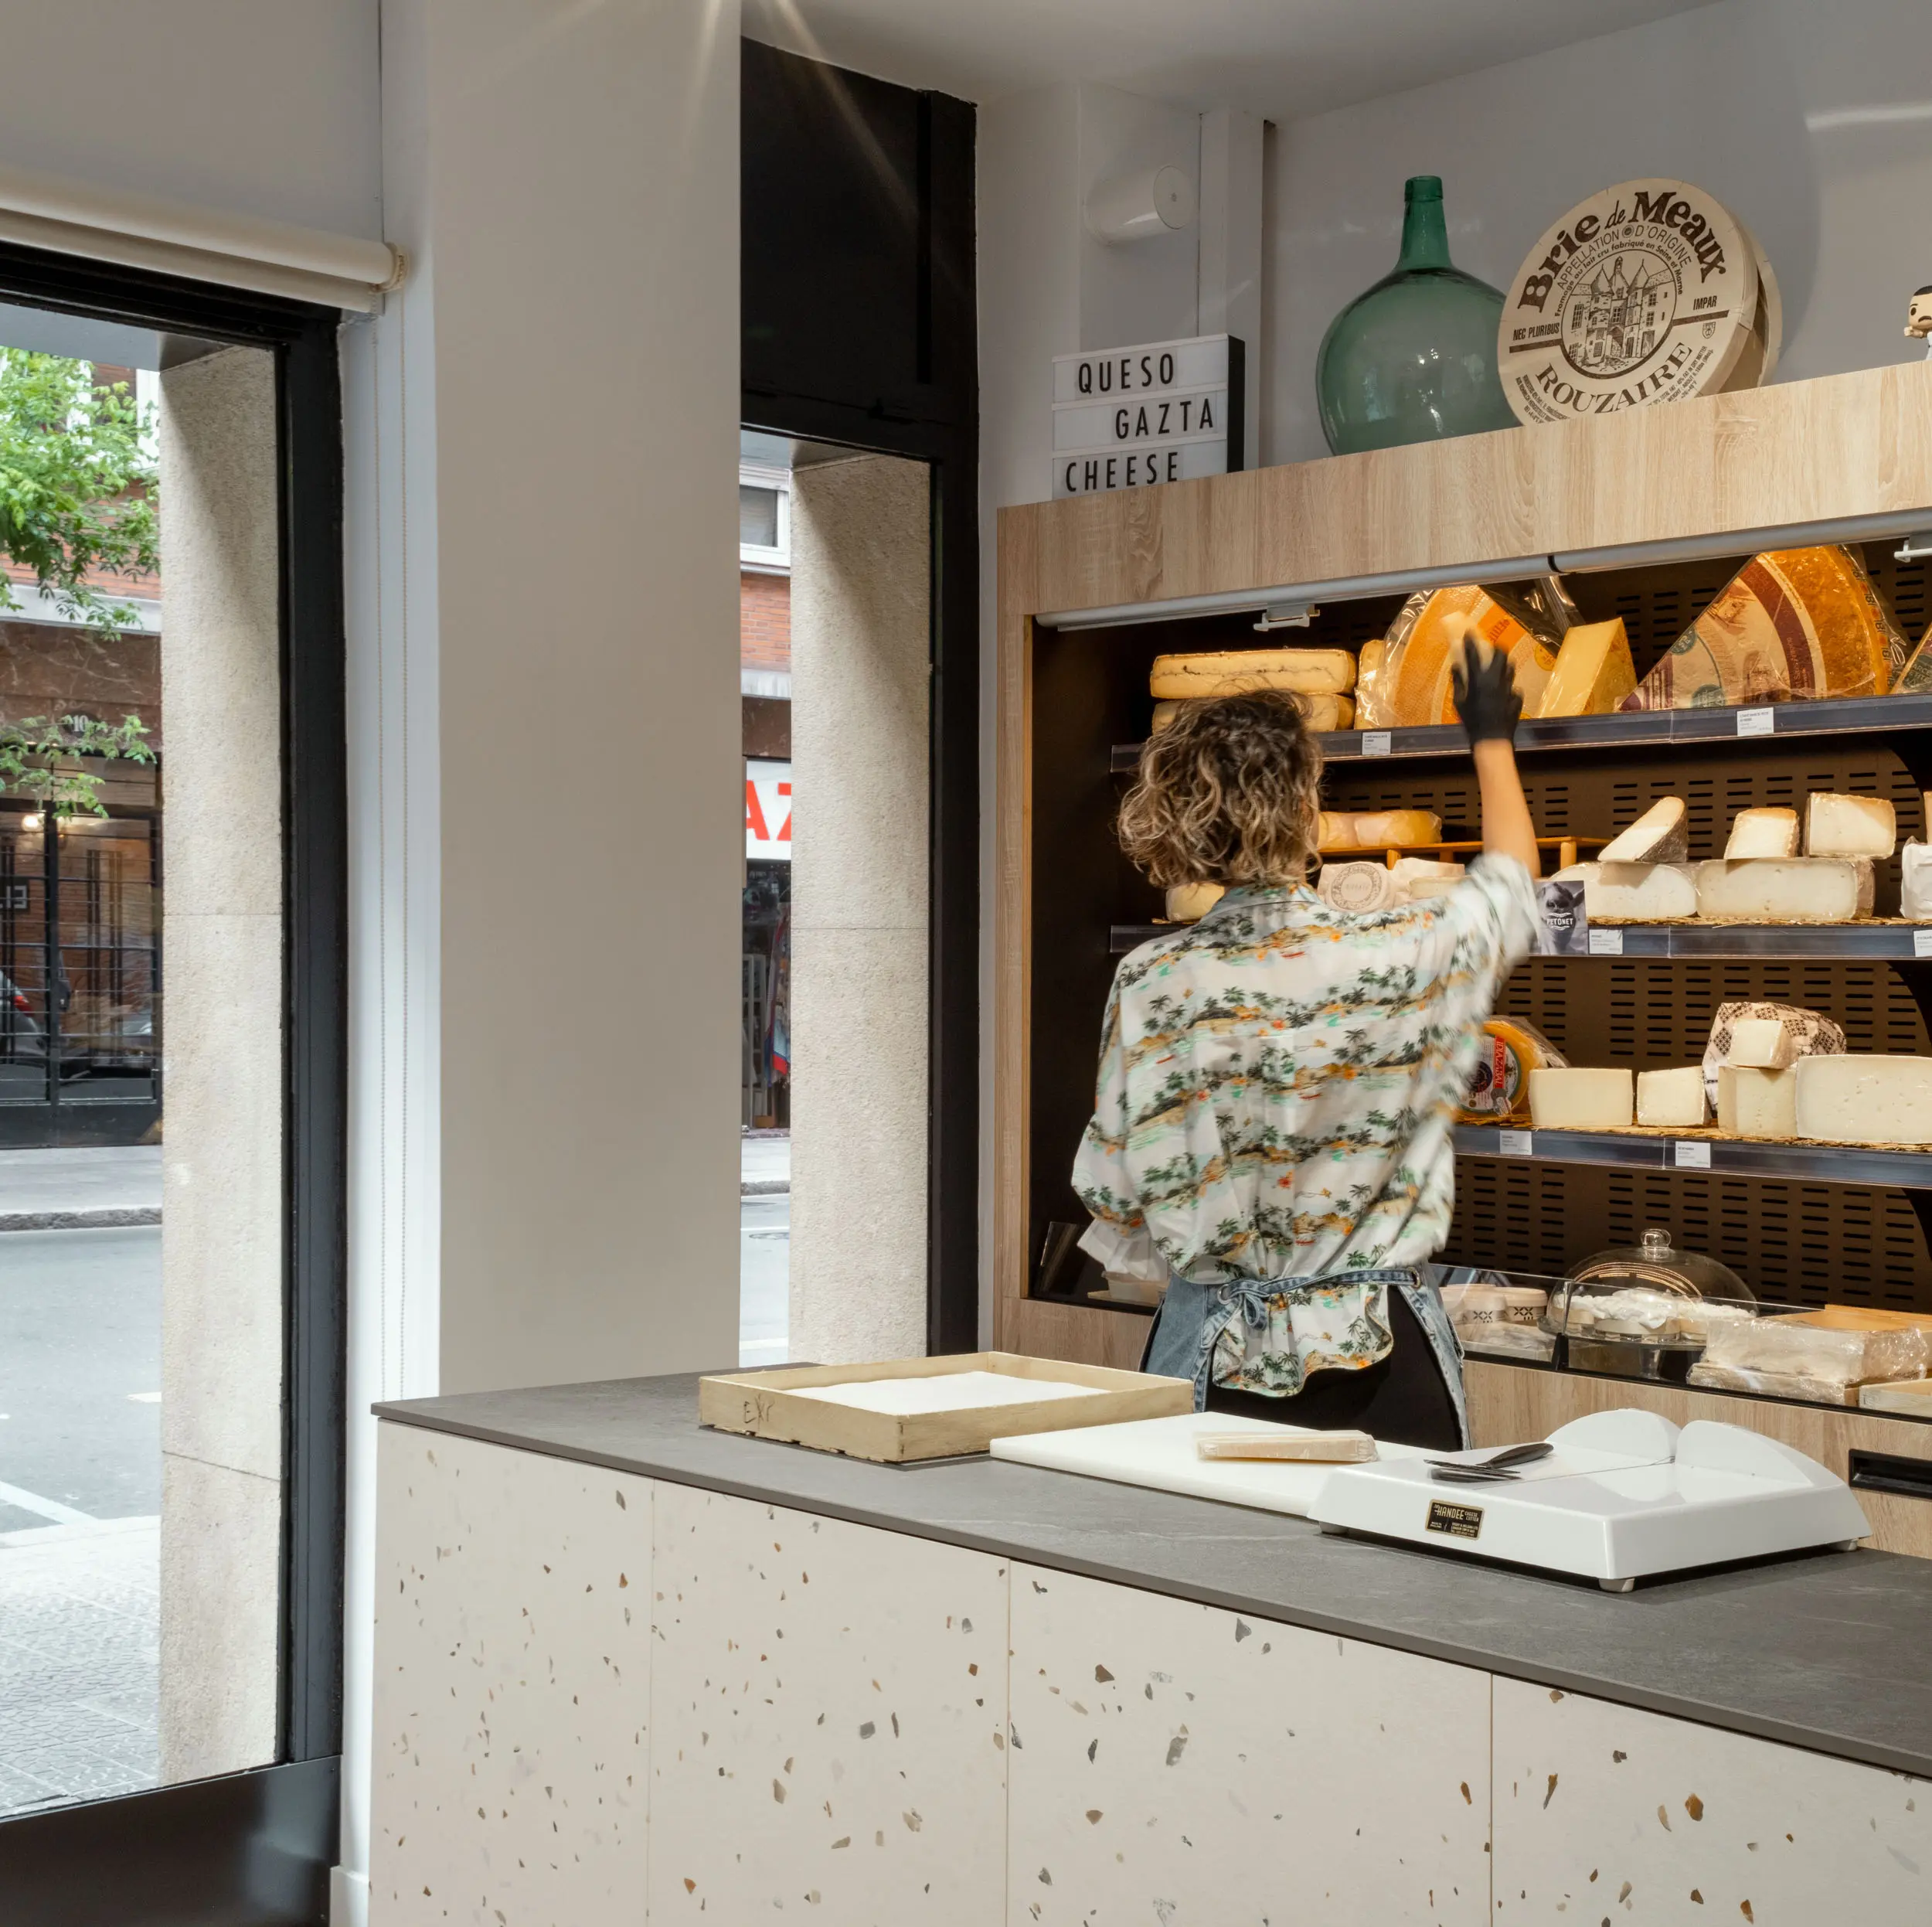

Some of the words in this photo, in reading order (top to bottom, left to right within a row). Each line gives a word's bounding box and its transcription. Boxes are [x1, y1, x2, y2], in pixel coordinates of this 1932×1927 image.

[1517, 214, 1601, 314] Brie
[1604, 199, 1626, 230] de
[1628, 191, 1726, 284] Meaux
[1597, 248, 1609, 258] cru
[1611, 240, 1645, 250] fabriqué
[1655, 244, 1672, 261] Seine
[1557, 229, 1620, 290] APPELLATION
[1634, 225, 1692, 268] D'ORIGINE
[1583, 257, 1596, 269] lait
[1670, 260, 1679, 268] et
[1574, 268, 1583, 279] au
[1674, 267, 1683, 295] Marne
[1554, 280, 1575, 317] Fromage
[1692, 294, 1717, 311] IMPAR
[1512, 327, 1526, 341] NEC
[1528, 322, 1560, 339] PLURIBUS
[1078, 353, 1174, 393] QUESO
[1536, 342, 1693, 414] ROUZAIRE
[1115, 398, 1213, 439] GAZTA
[1066, 451, 1179, 492] CHEESE
[73, 715, 90, 732] 10
[1495, 1041, 1505, 1086] IDIAZABAL
[1435, 1506, 1464, 1520] HANDEE
